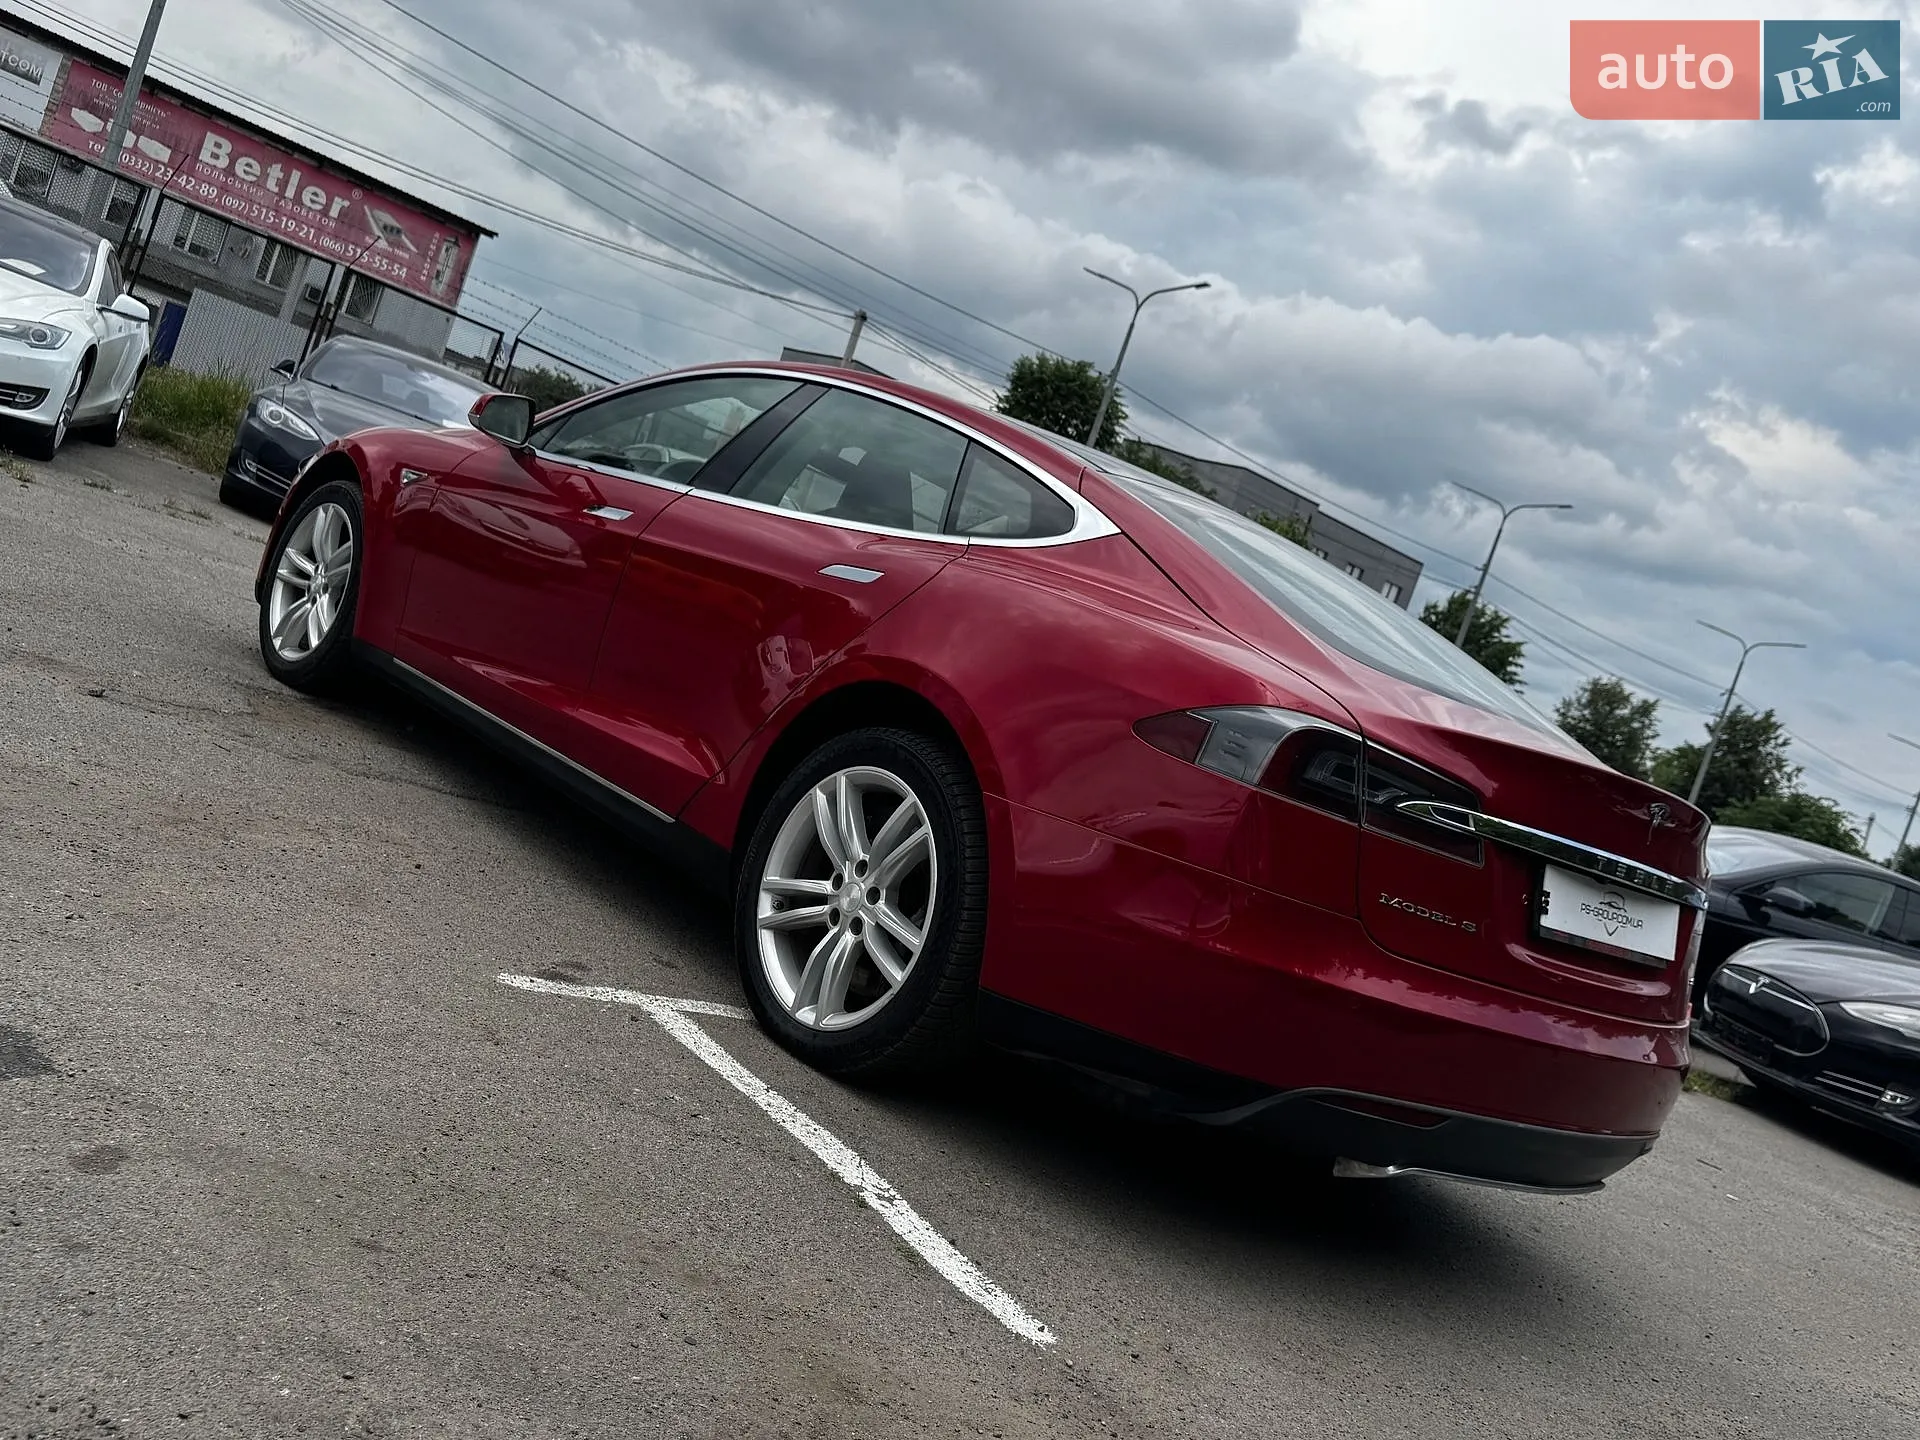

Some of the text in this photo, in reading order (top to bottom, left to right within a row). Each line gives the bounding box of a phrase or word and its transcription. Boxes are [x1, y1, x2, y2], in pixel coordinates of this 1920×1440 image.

[198, 131, 350, 218] Betler
[221, 194, 249, 216] (097)
[319, 235, 345, 255] (066)
[1379, 892, 1477, 932] MODEL S
